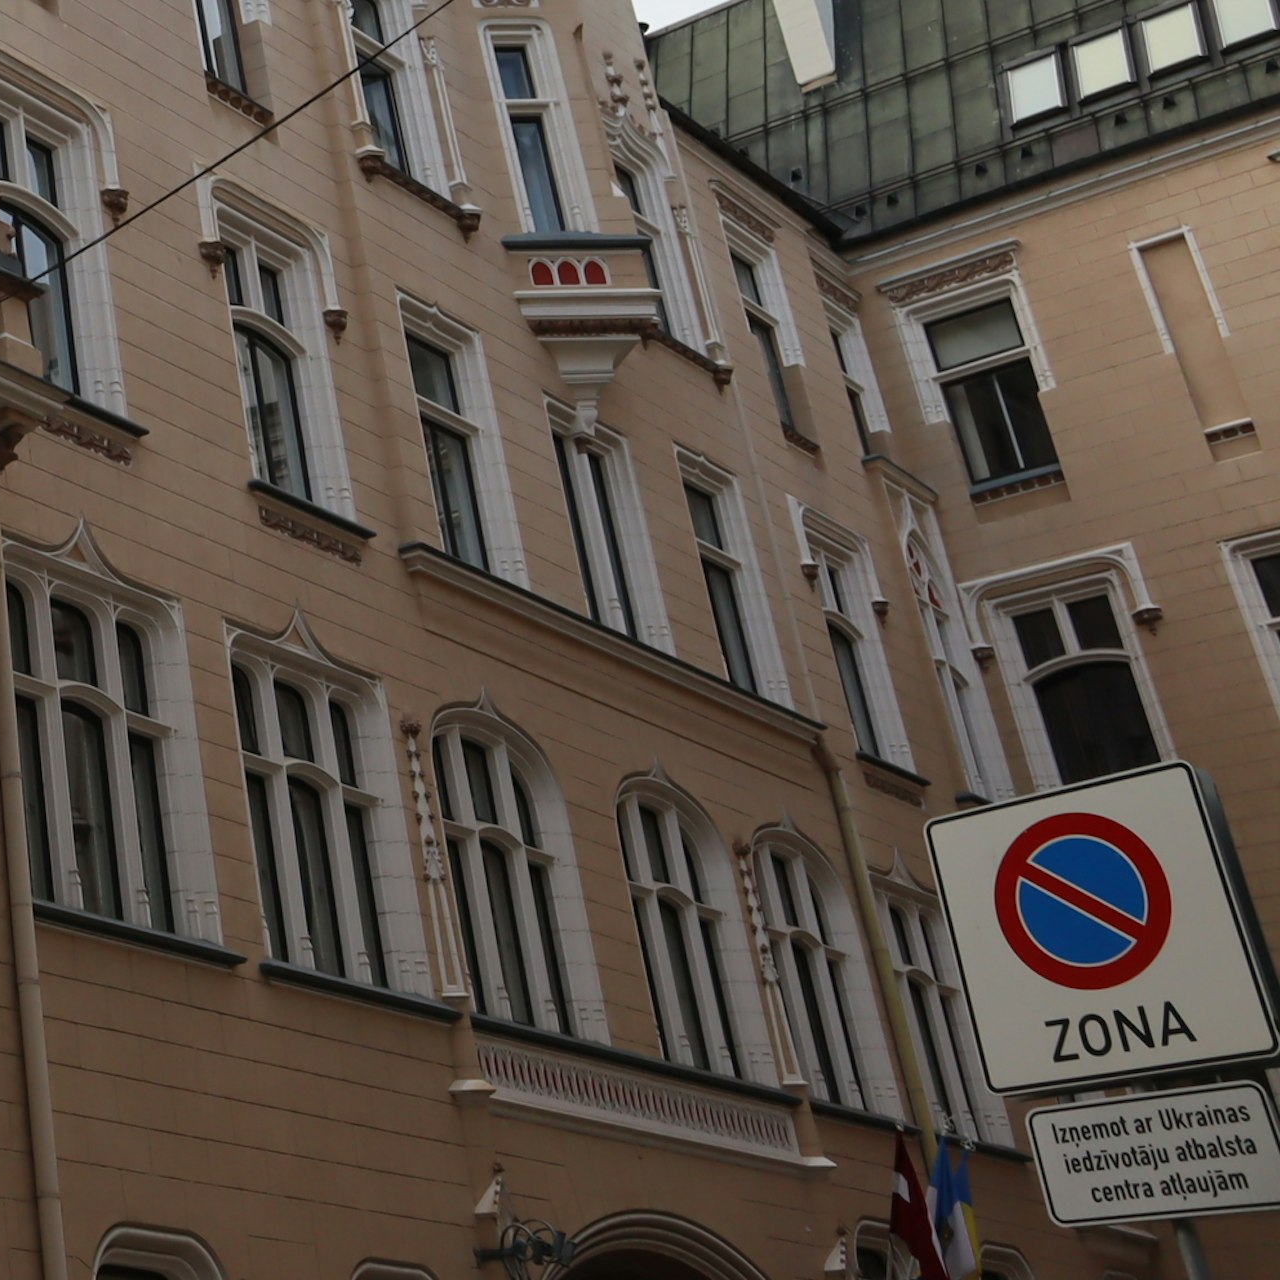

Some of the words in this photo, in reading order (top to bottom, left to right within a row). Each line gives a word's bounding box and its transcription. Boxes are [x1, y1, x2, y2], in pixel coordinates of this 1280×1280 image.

[1044, 1001, 1197, 1063] ZONA
[1051, 1116, 1129, 1147] Izņemot
[1134, 1116, 1153, 1134] ar
[1158, 1105, 1250, 1131] Ukrainas
[1063, 1145, 1170, 1174] iedzīvotāju
[1176, 1134, 1258, 1162] atbalsta
[1091, 1179, 1154, 1203] centra
[1160, 1170, 1249, 1200] atļaujām
